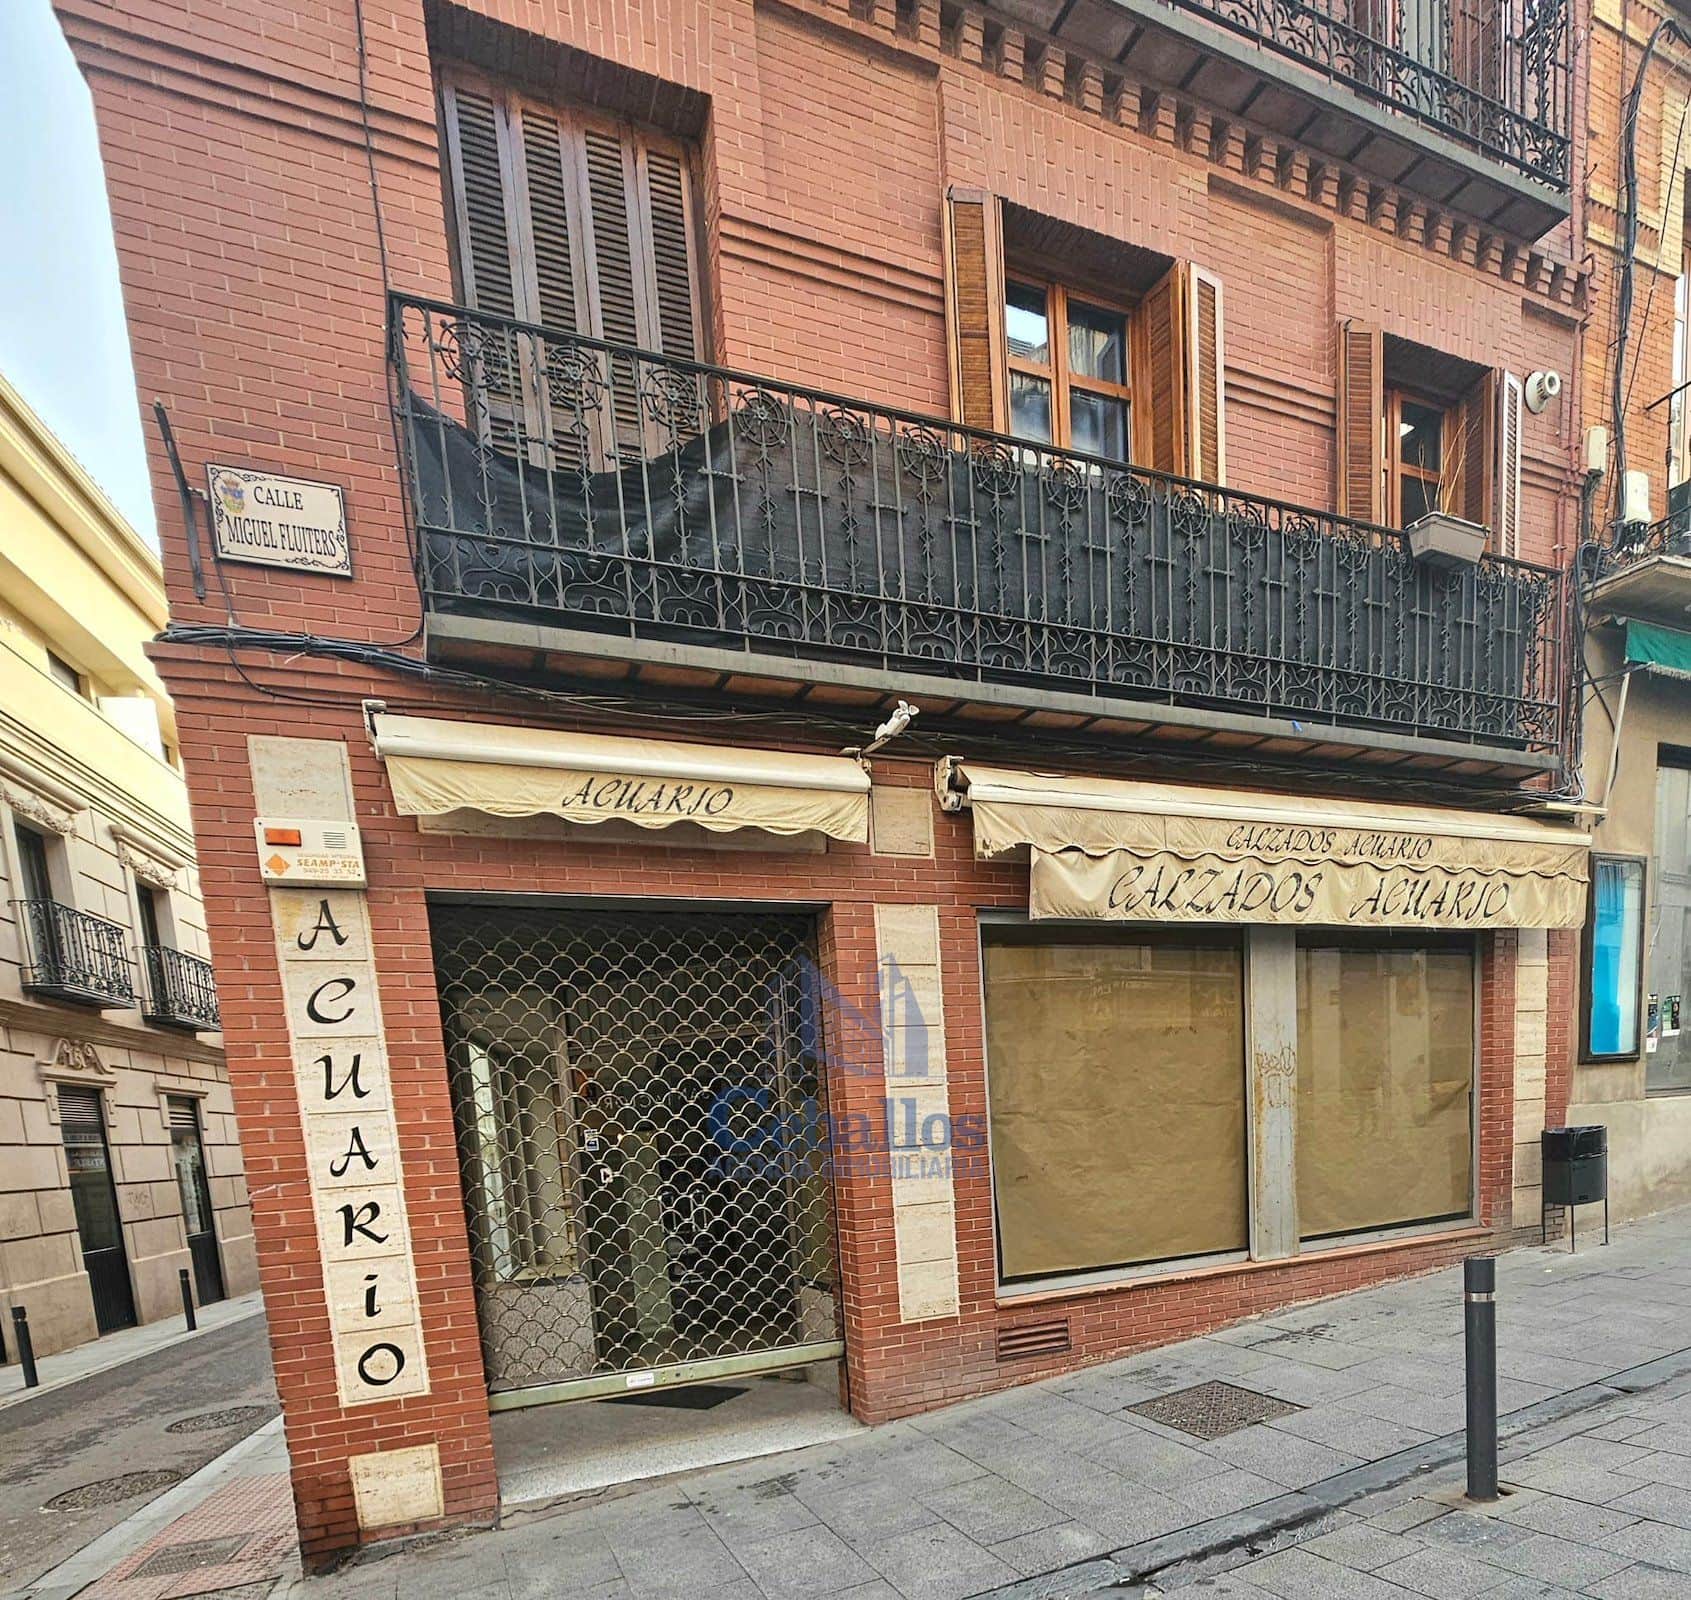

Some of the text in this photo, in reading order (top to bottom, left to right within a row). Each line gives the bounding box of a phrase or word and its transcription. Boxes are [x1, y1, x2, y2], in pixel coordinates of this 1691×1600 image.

[253, 486, 304, 510] CALLE
[225, 515, 337, 557] MIGUEL FLUITERS
[561, 776, 735, 816] ACUARIO
[1226, 825, 1433, 860] CALZADOS ACUARIO
[1108, 865, 1510, 921] CALZADOS ACUARIO
